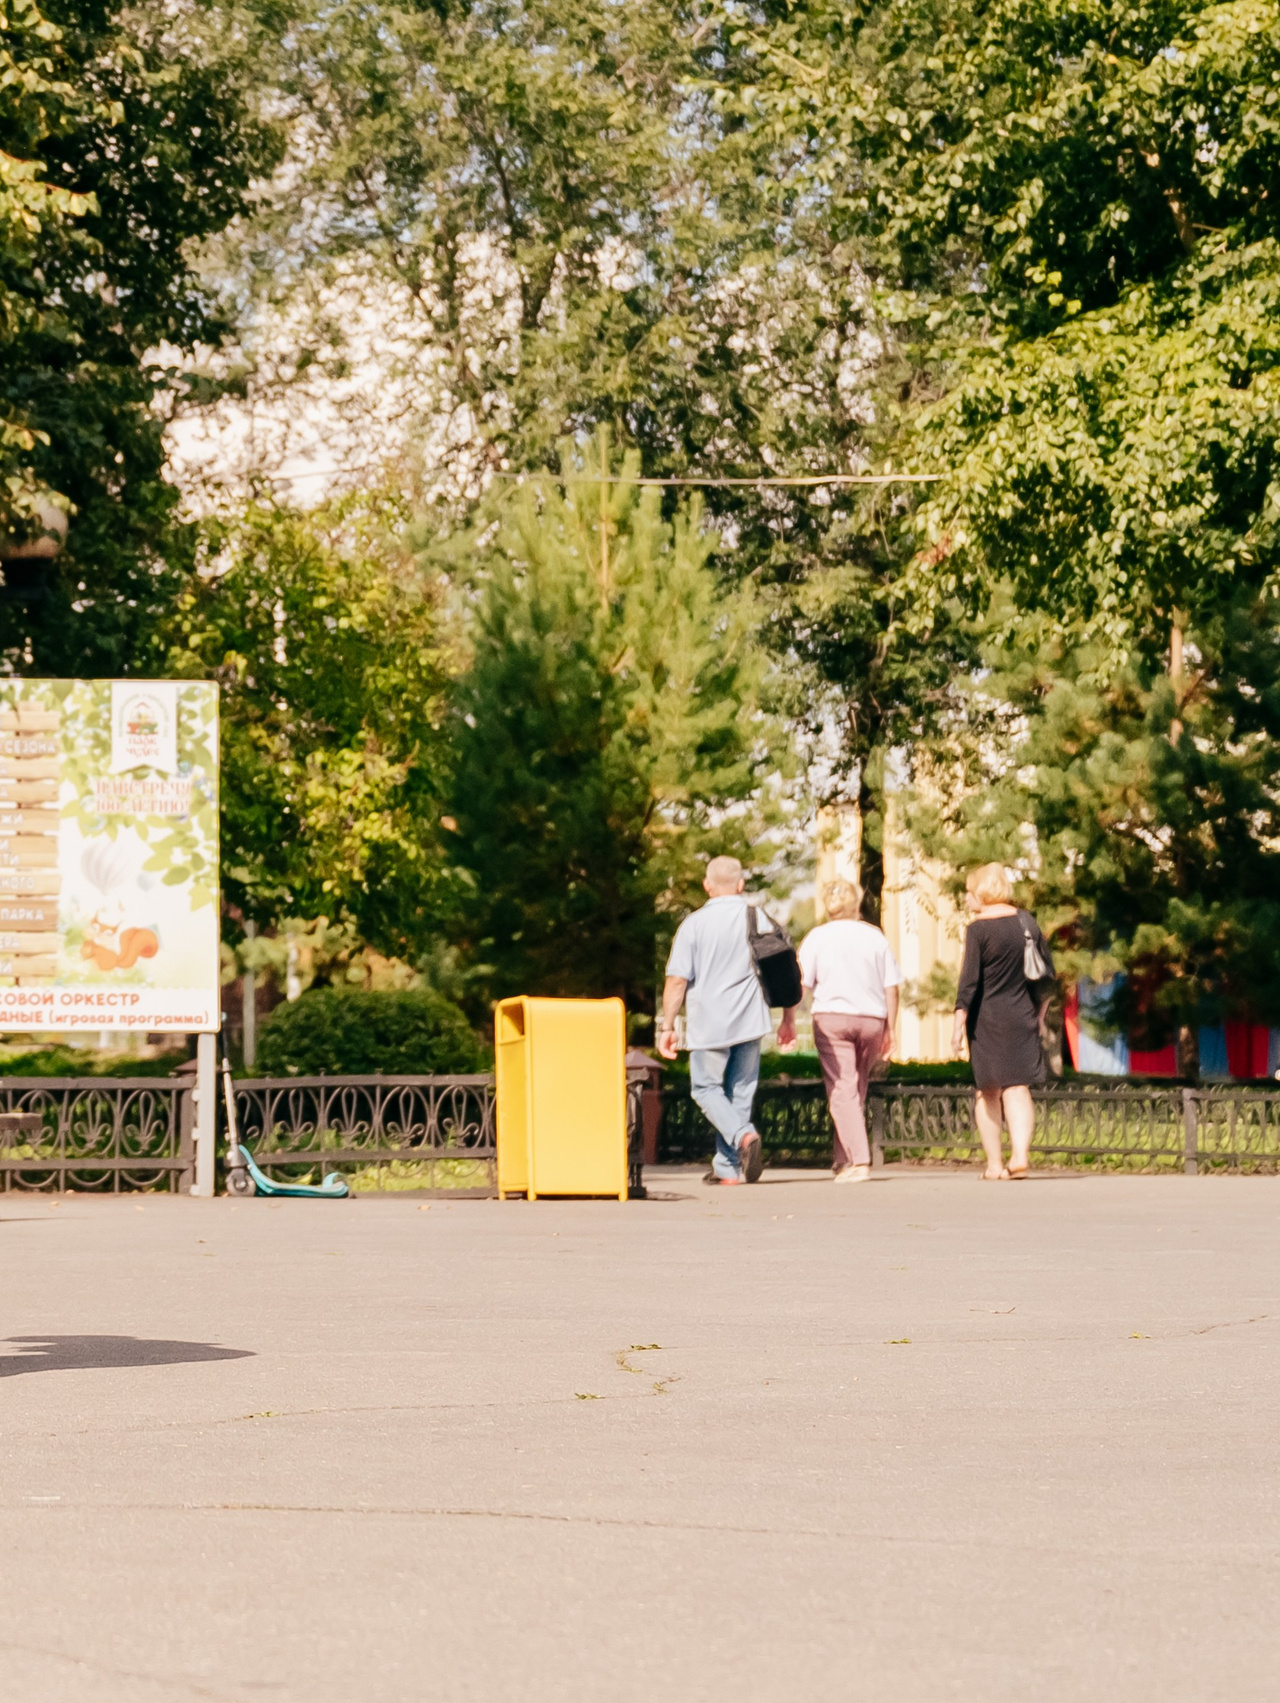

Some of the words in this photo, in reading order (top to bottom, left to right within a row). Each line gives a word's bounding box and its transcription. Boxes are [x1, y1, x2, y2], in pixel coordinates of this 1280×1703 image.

[4, 739, 56, 754] СЕЗОНА
[0, 907, 44, 921] ПАРКА
[60, 992, 140, 1006] ОРКЕСТР
[49, 1010, 114, 1026] (игровая
[119, 1010, 209, 1027] программа)
